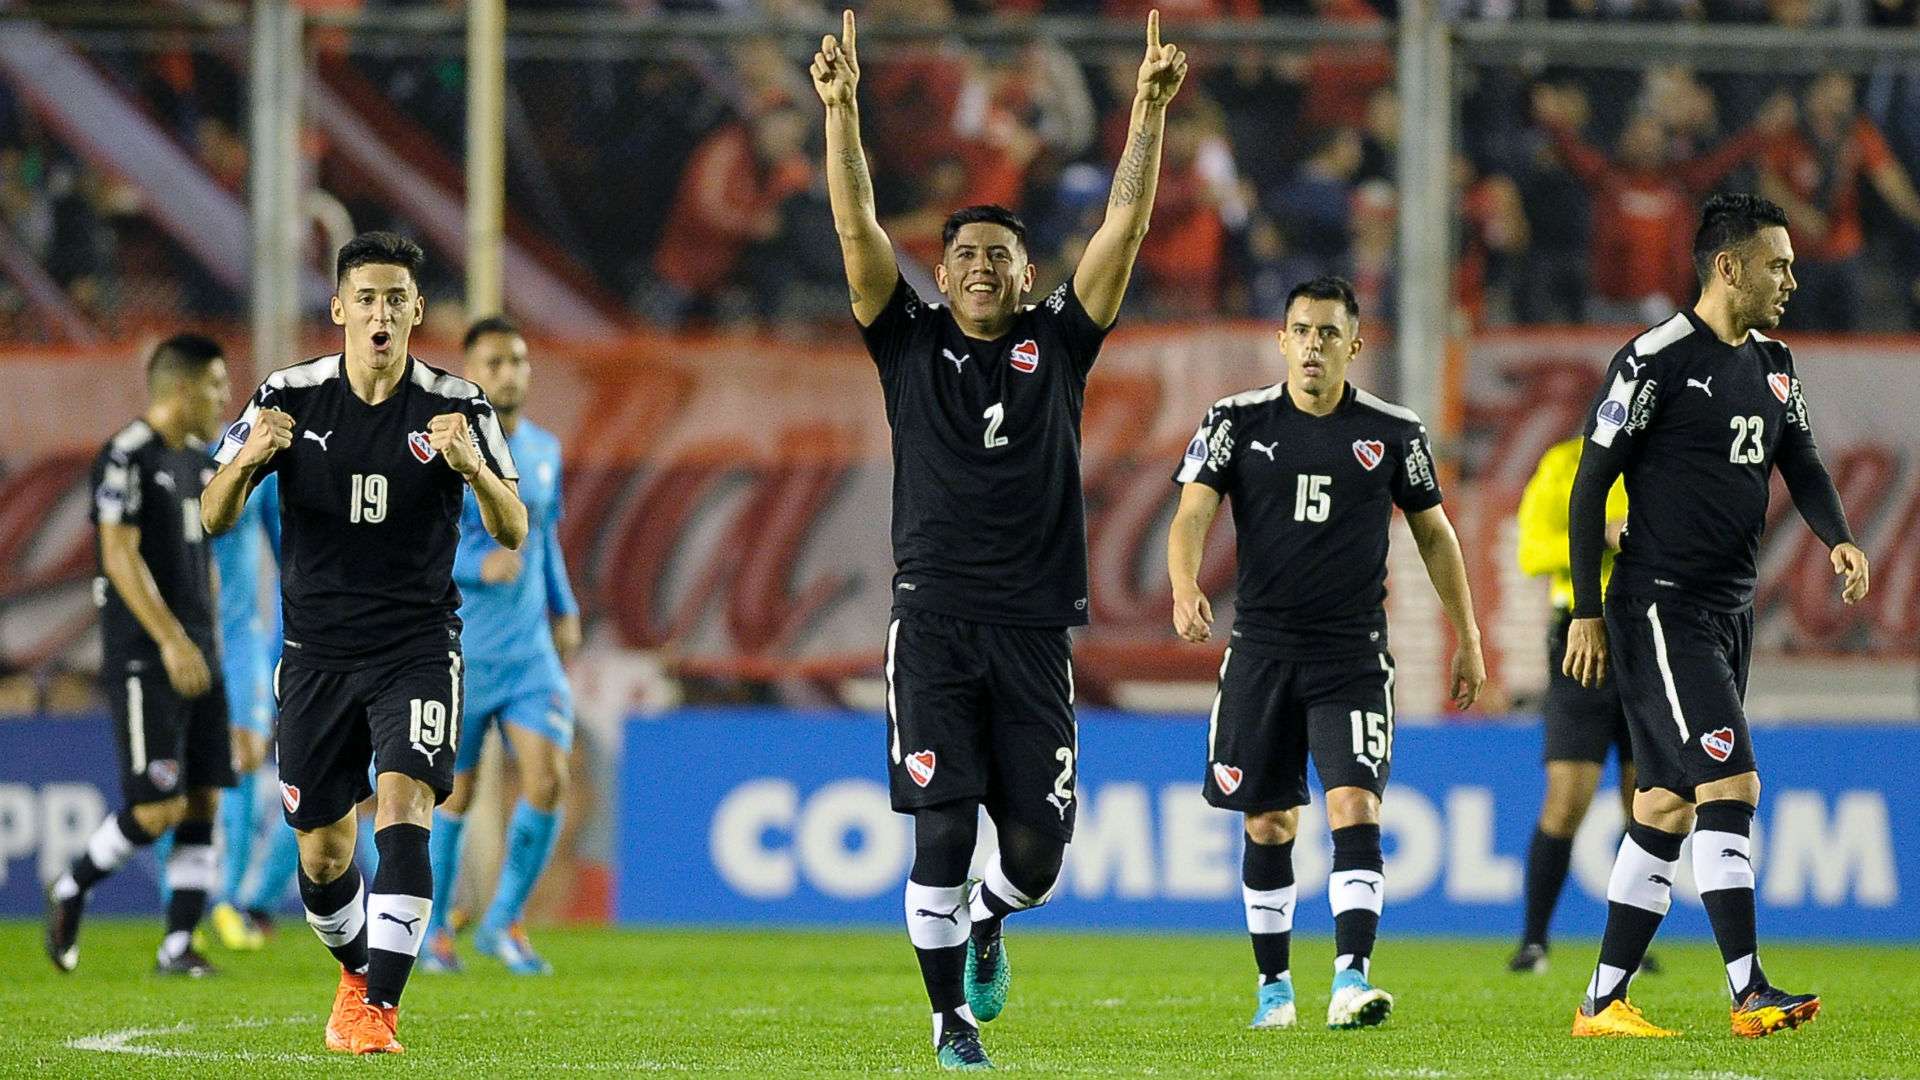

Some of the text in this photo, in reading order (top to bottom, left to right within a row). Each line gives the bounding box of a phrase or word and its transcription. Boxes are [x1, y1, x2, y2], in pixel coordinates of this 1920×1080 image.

[983, 402, 1008, 448] 2
[1730, 415, 1764, 464] 23
[350, 473, 388, 523] 19
[1294, 473, 1332, 522] 15
[410, 699, 446, 745] 19
[1351, 710, 1386, 759] 15
[1054, 747, 1073, 799] 2
